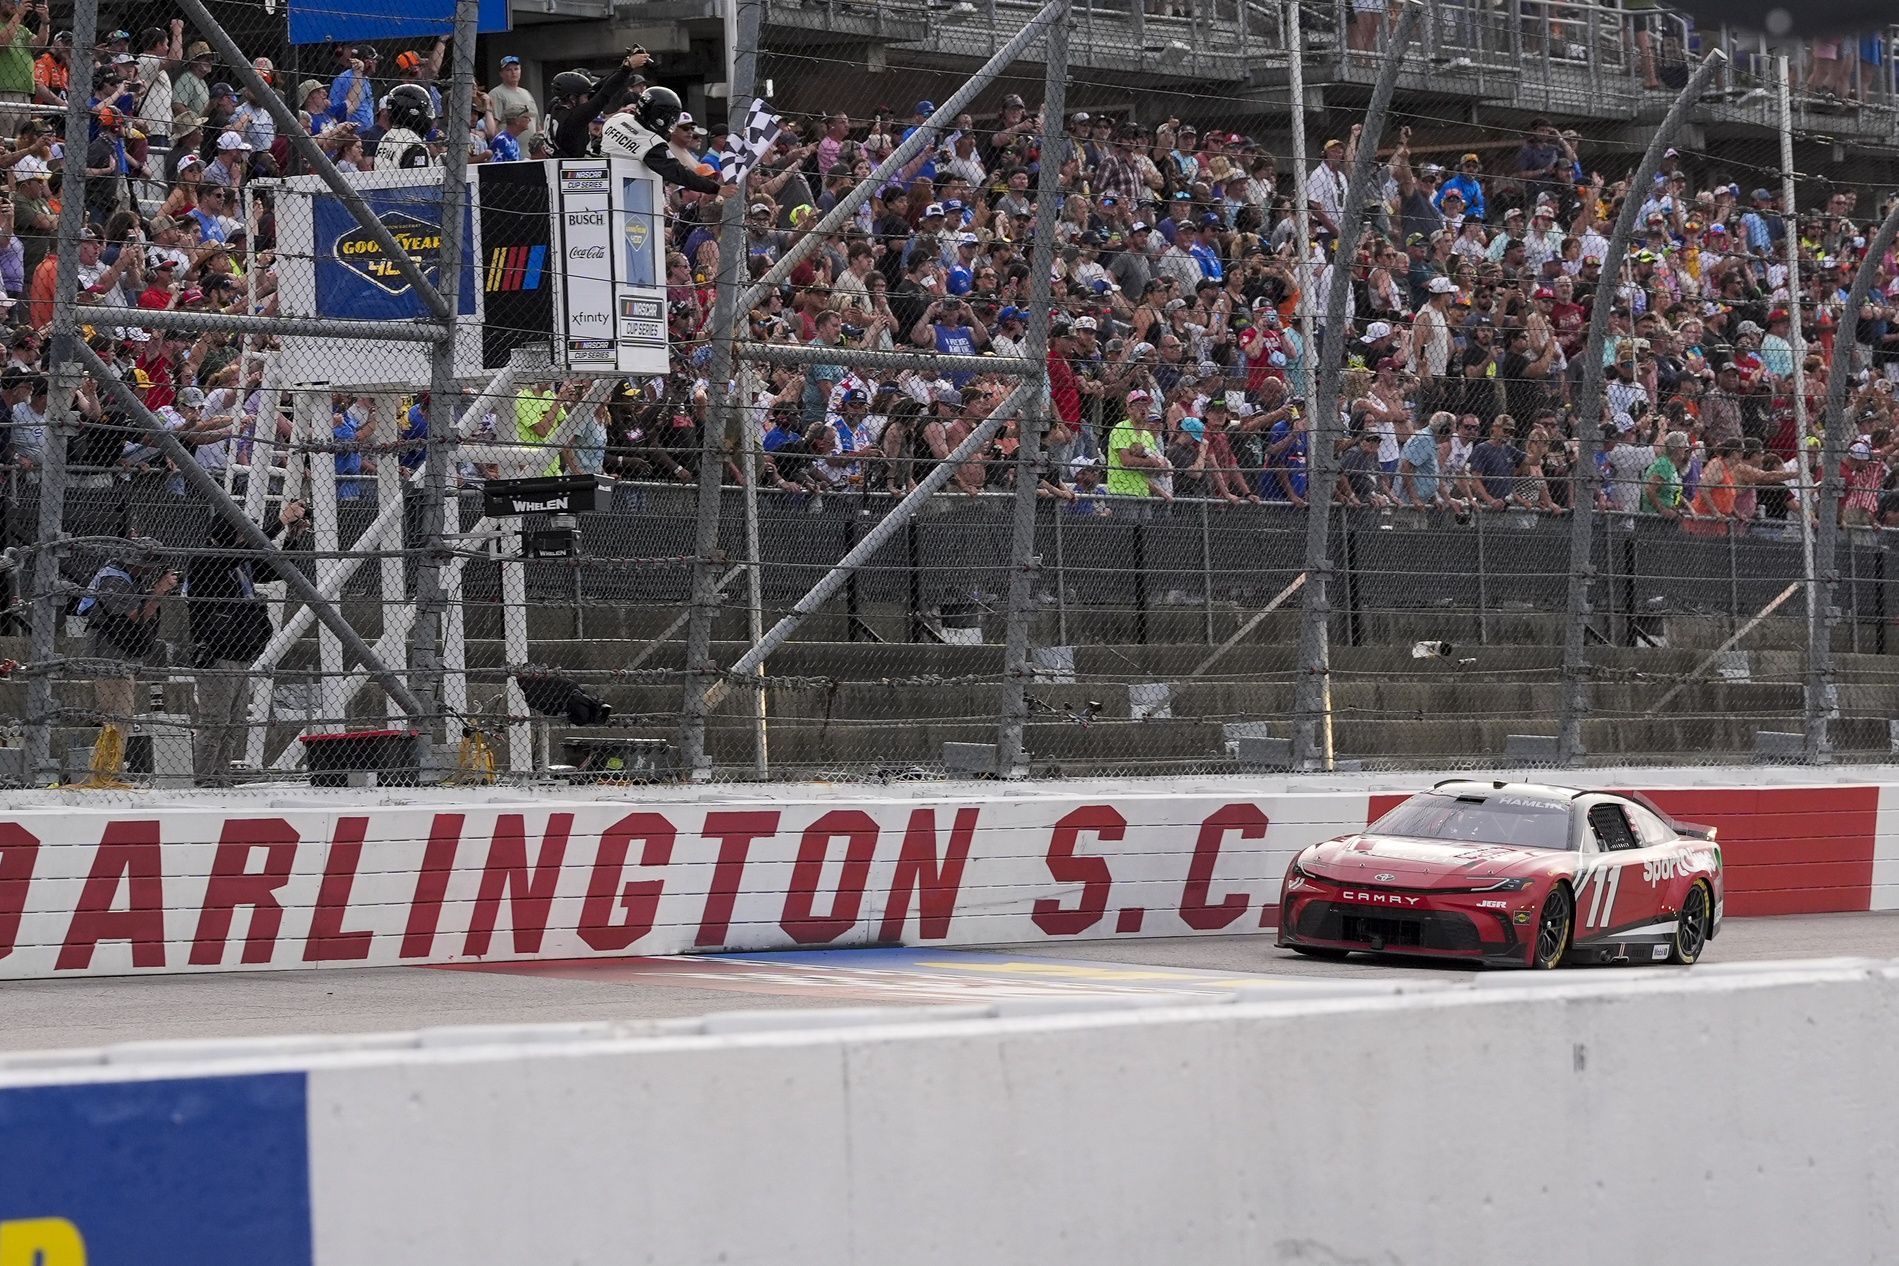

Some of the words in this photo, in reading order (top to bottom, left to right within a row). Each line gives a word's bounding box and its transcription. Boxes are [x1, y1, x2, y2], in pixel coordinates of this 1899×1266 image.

[604, 126, 641, 155] OFFICIAL
[574, 171, 603, 179] NASCAR
[568, 214, 604, 226] BUSCH
[342, 236, 442, 255] GOOYEAR
[633, 301, 658, 317] NASCAR
[572, 312, 610, 326] xfinity
[626, 322, 638, 335] CUP
[638, 323, 659, 337] SERIES
[582, 341, 610, 349] NASCAR
[512, 496, 569, 513] WHELEN
[539, 549, 567, 557] WHELEN
[1498, 797, 1568, 812] HAMLIN
[1030, 803, 1279, 936] S.C.
[1343, 891, 1420, 906] CAMRY
[1585, 864, 1623, 928] 11
[1475, 900, 1507, 909] JGR
